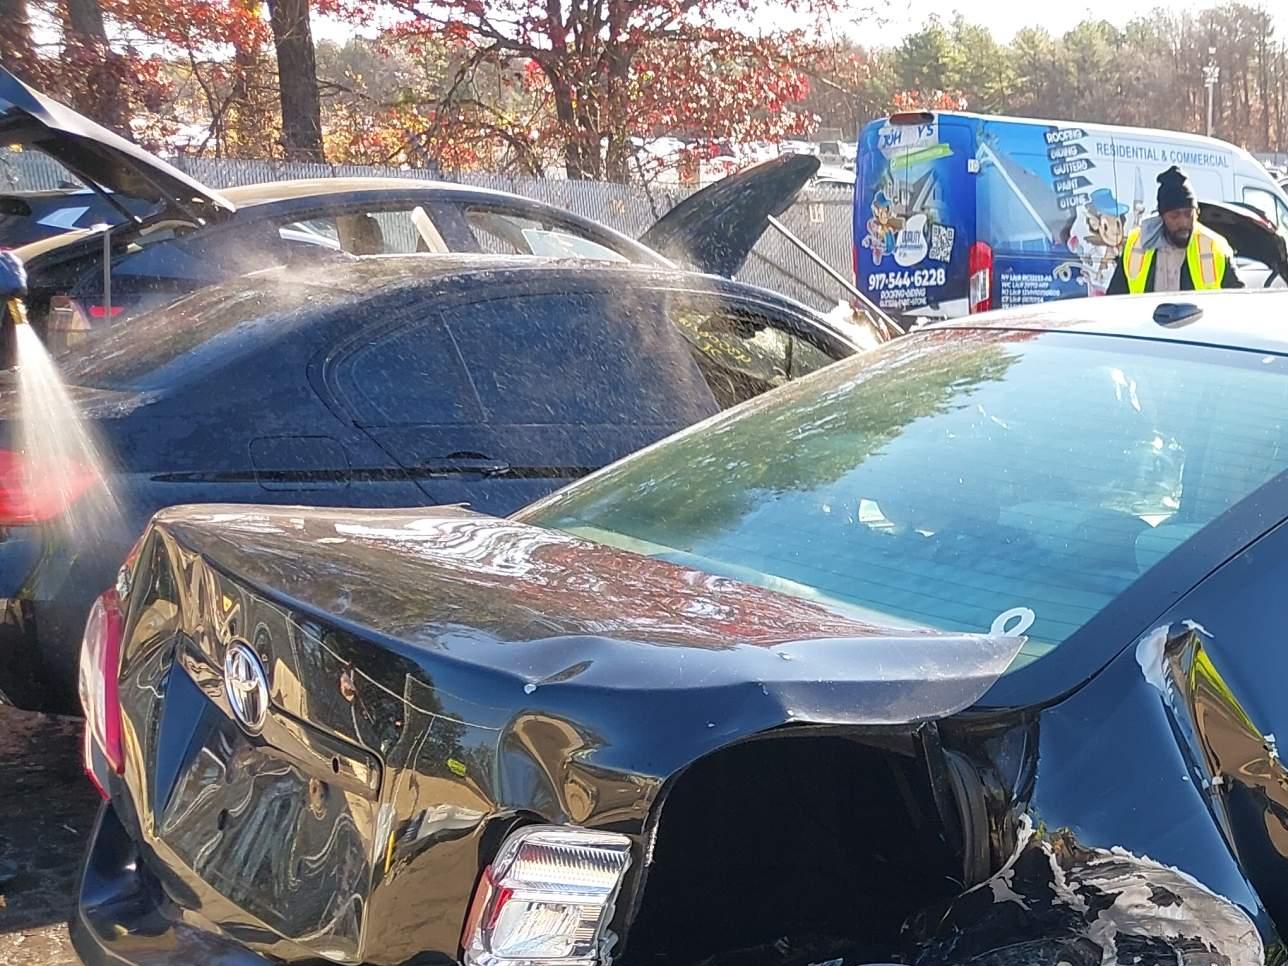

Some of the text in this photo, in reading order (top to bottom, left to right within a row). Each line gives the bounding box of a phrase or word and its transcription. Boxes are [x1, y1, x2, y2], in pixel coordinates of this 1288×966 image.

[1096, 143, 1229, 168] RESIDENTIAL & COMMERCIAL
